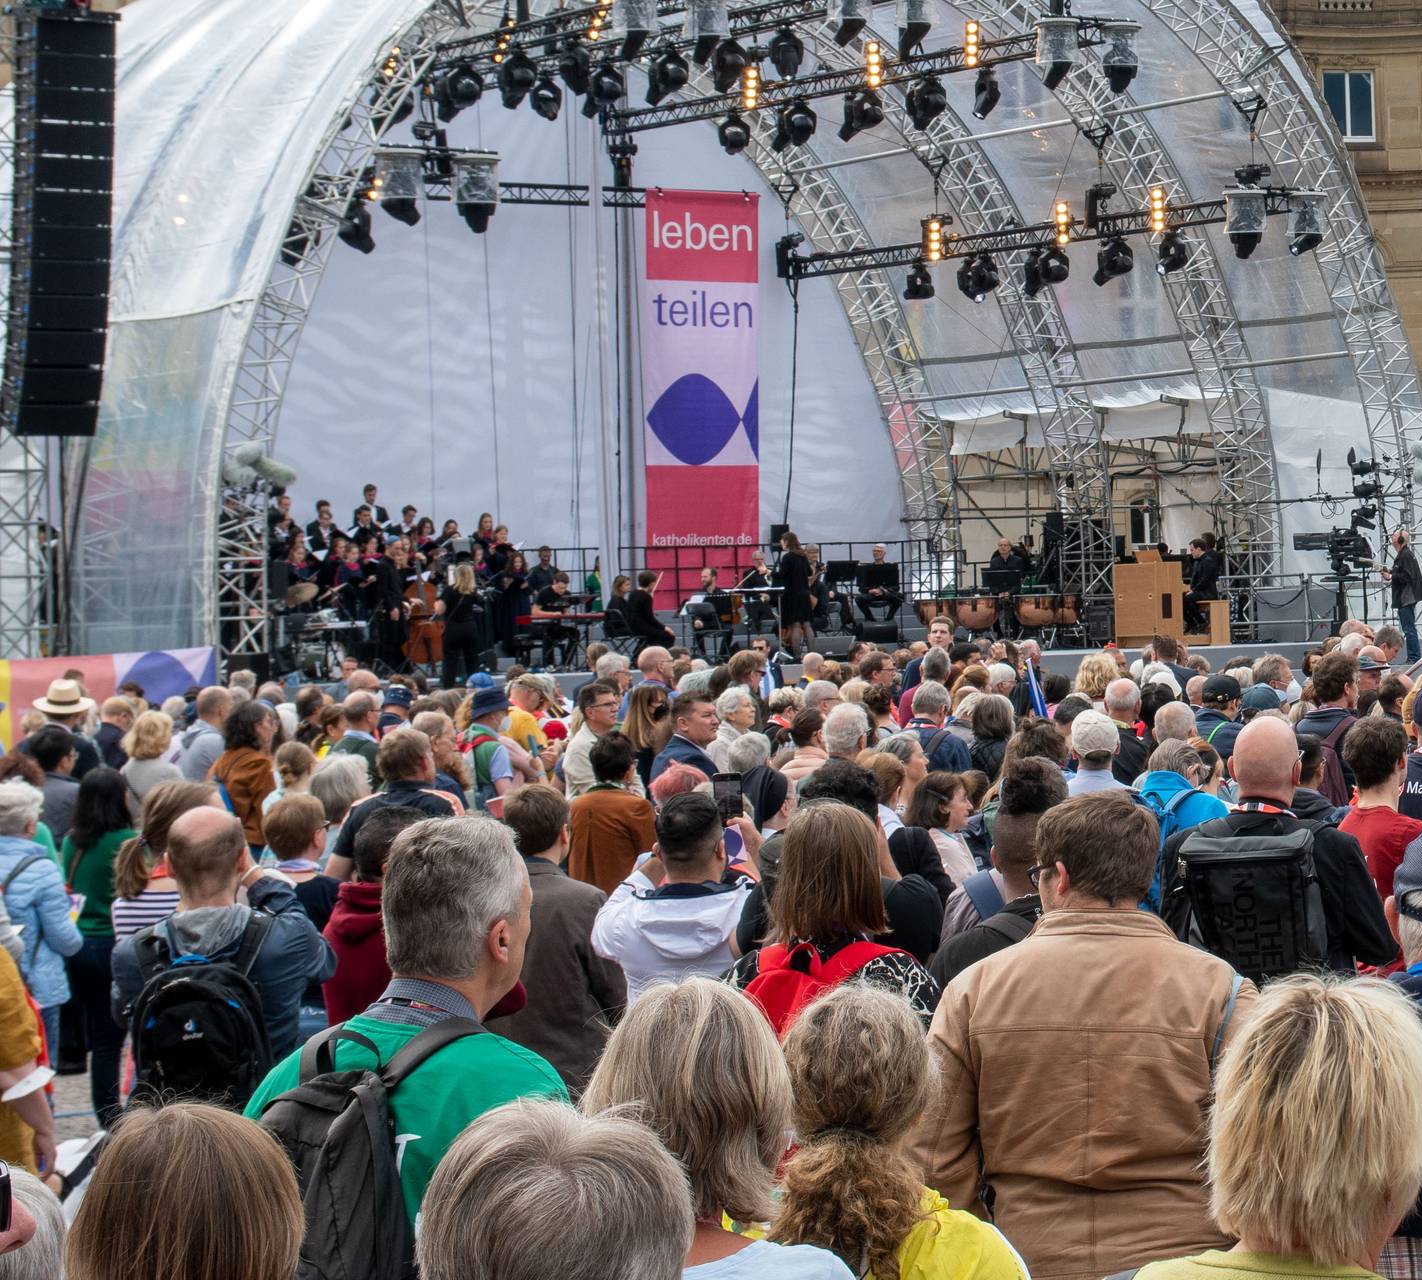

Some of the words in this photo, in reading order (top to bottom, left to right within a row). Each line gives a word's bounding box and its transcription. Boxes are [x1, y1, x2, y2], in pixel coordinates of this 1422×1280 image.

[652, 210, 753, 252] leben
[652, 290, 753, 328] teilen
[652, 533, 752, 548] katholikentag.de
[1260, 914, 1284, 967] THE
